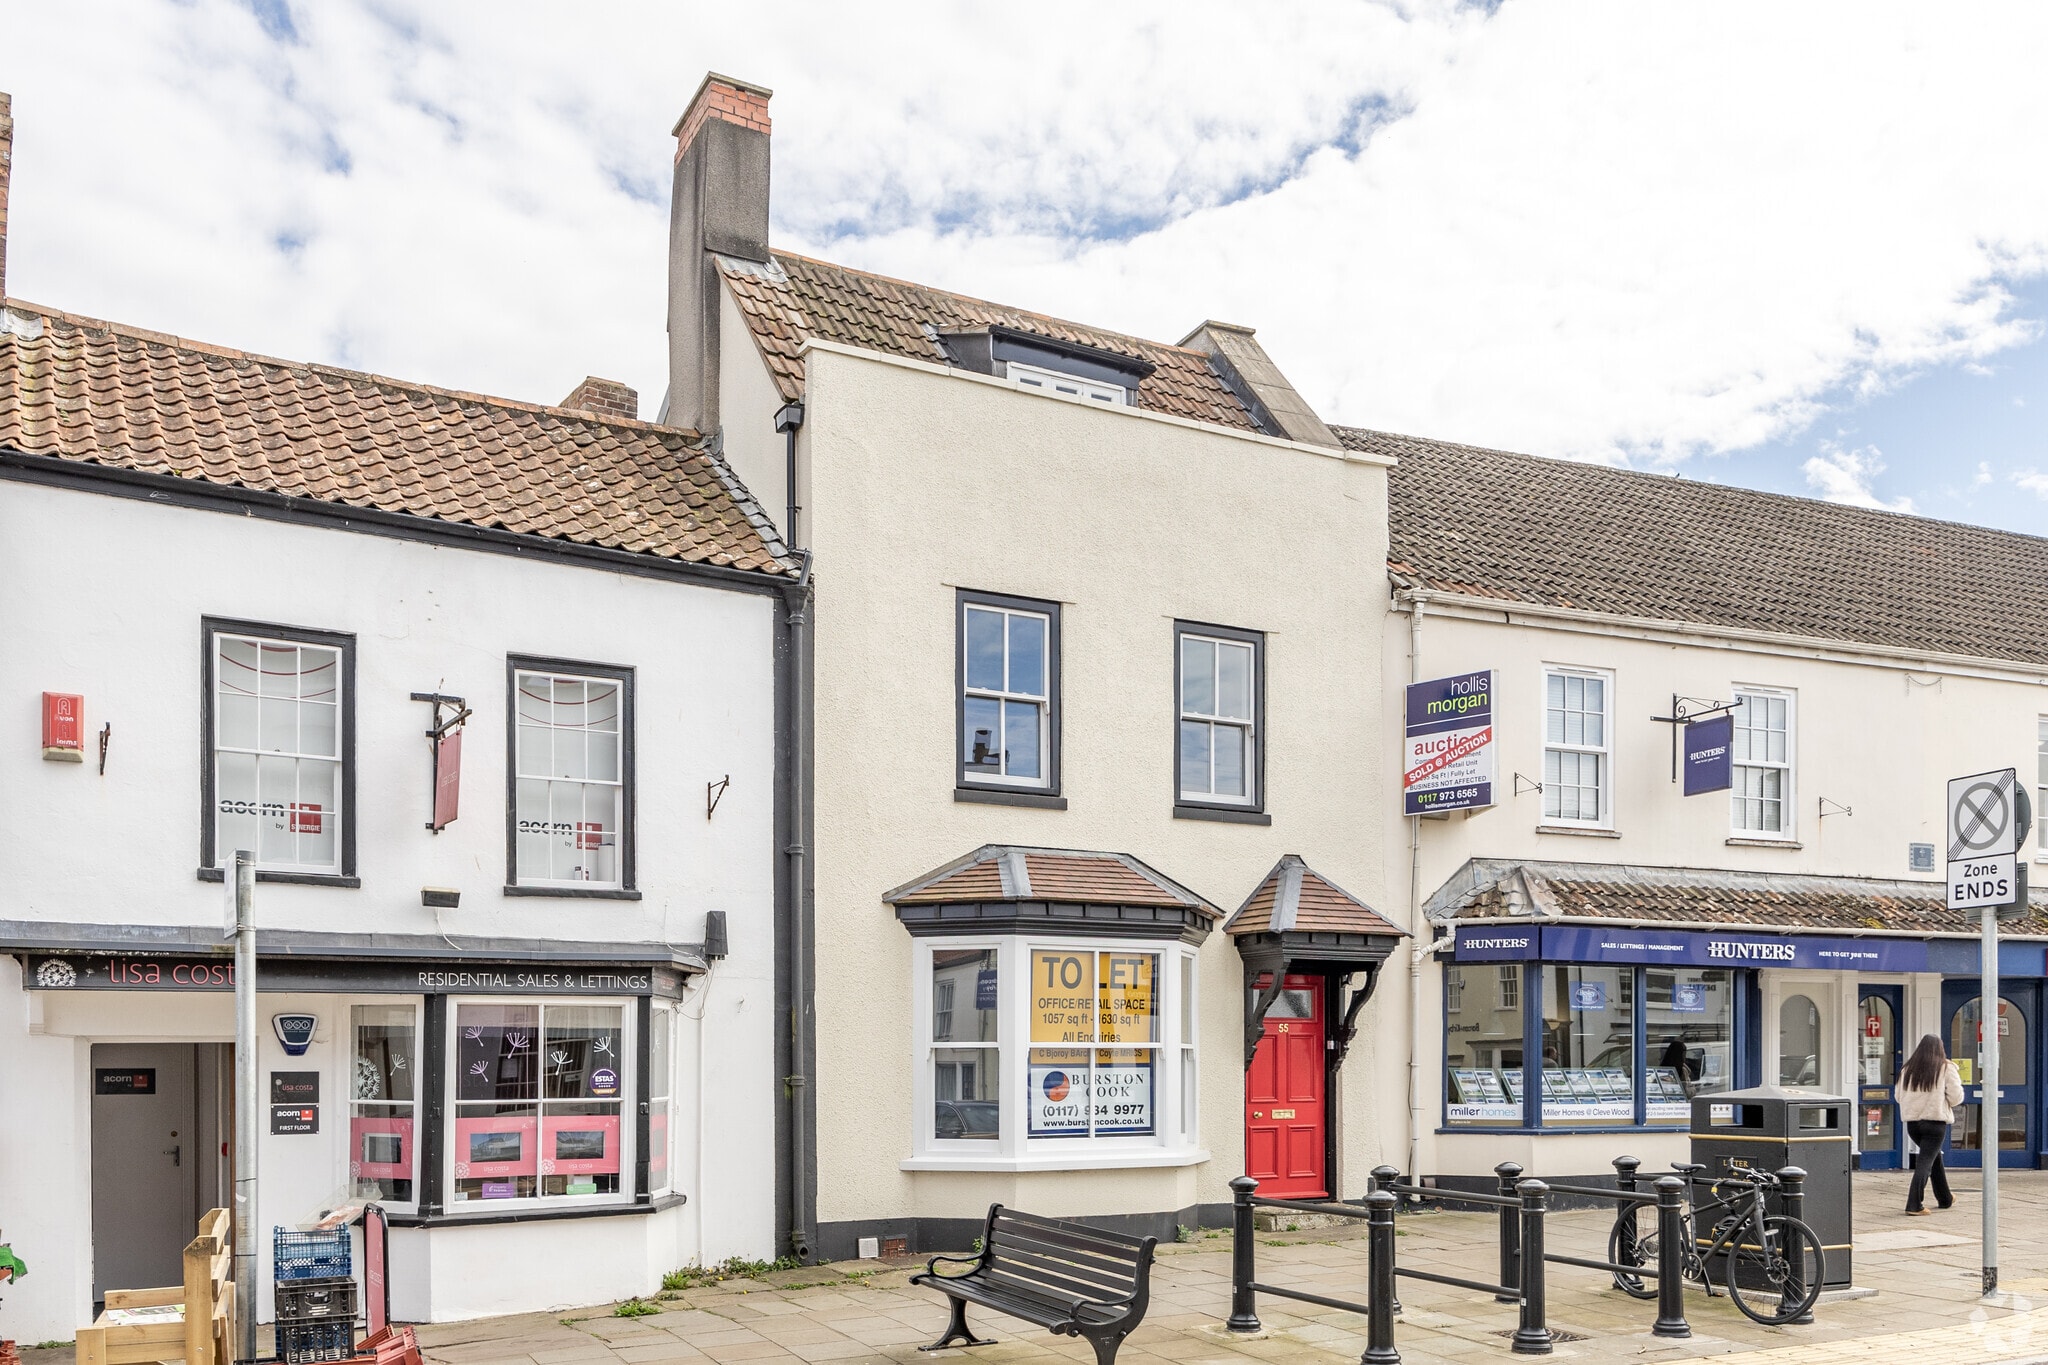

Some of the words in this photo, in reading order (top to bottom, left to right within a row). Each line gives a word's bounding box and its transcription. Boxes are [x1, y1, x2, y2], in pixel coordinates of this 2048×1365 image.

[1451, 675, 1488, 696] hollis
[1427, 693, 1488, 715] morgan
[1408, 763, 1434, 783] SOLD
[1444, 733, 1488, 763] AUCTION
[1689, 746, 1726, 761] HUNTERS
[1409, 781, 1440, 791] BUSINESS
[1440, 779, 1453, 787] NOT
[1454, 775, 1487, 785] AFFECTED
[1418, 792, 1437, 804] 0117
[1439, 790, 1455, 801] 973
[1456, 787, 1478, 799] 6565
[275, 822, 285, 830] by
[290, 823, 321, 832] SNERGIE
[564, 840, 573, 848] by
[1963, 864, 1998, 878] Zone
[1955, 879, 2008, 900] ENDS
[1464, 938, 1529, 949] HUNTERS
[1707, 941, 1796, 960] HUNTERS
[110, 958, 160, 984] lisa
[172, 962, 236, 985] cost
[1042, 956, 1083, 990] TO
[1096, 958, 1144, 990] ET
[418, 971, 512, 987] RESIDENTIAL
[517, 973, 559, 988] SALES
[564, 974, 575, 988] &
[580, 974, 648, 989] LETTINGS
[1038, 997, 1111, 1010] OFFICE/REAIL
[1114, 998, 1145, 1010] SPACE
[1043, 1013, 1065, 1024] 1057
[1067, 1016, 1079, 1026] sq
[1081, 1013, 1088, 1024] ft
[1120, 1016, 1131, 1026] sq
[1133, 1014, 1140, 1025] ft
[1062, 1032, 1074, 1042] All
[1077, 1031, 1121, 1042] Eniries
[103, 1075, 132, 1083] acorn
[282, 1082, 294, 1091] lisa
[295, 1081, 314, 1091] costa
[276, 1109, 300, 1117] acorn
[1042, 1104, 1079, 1117] (0117)
[1113, 1104, 1145, 1115] 9977
[1450, 1106, 1480, 1117] miller
[1481, 1107, 1517, 1117] homes
[1543, 1108, 1560, 1117] Miller
[1562, 1108, 1585, 1116] Homes
[1592, 1108, 1610, 1116] Cleve
[1611, 1108, 1630, 1116] Wood
[1042, 1117, 1146, 1128] www.burstncook.co.uk
[1723, 1159, 1748, 1168] LTER
